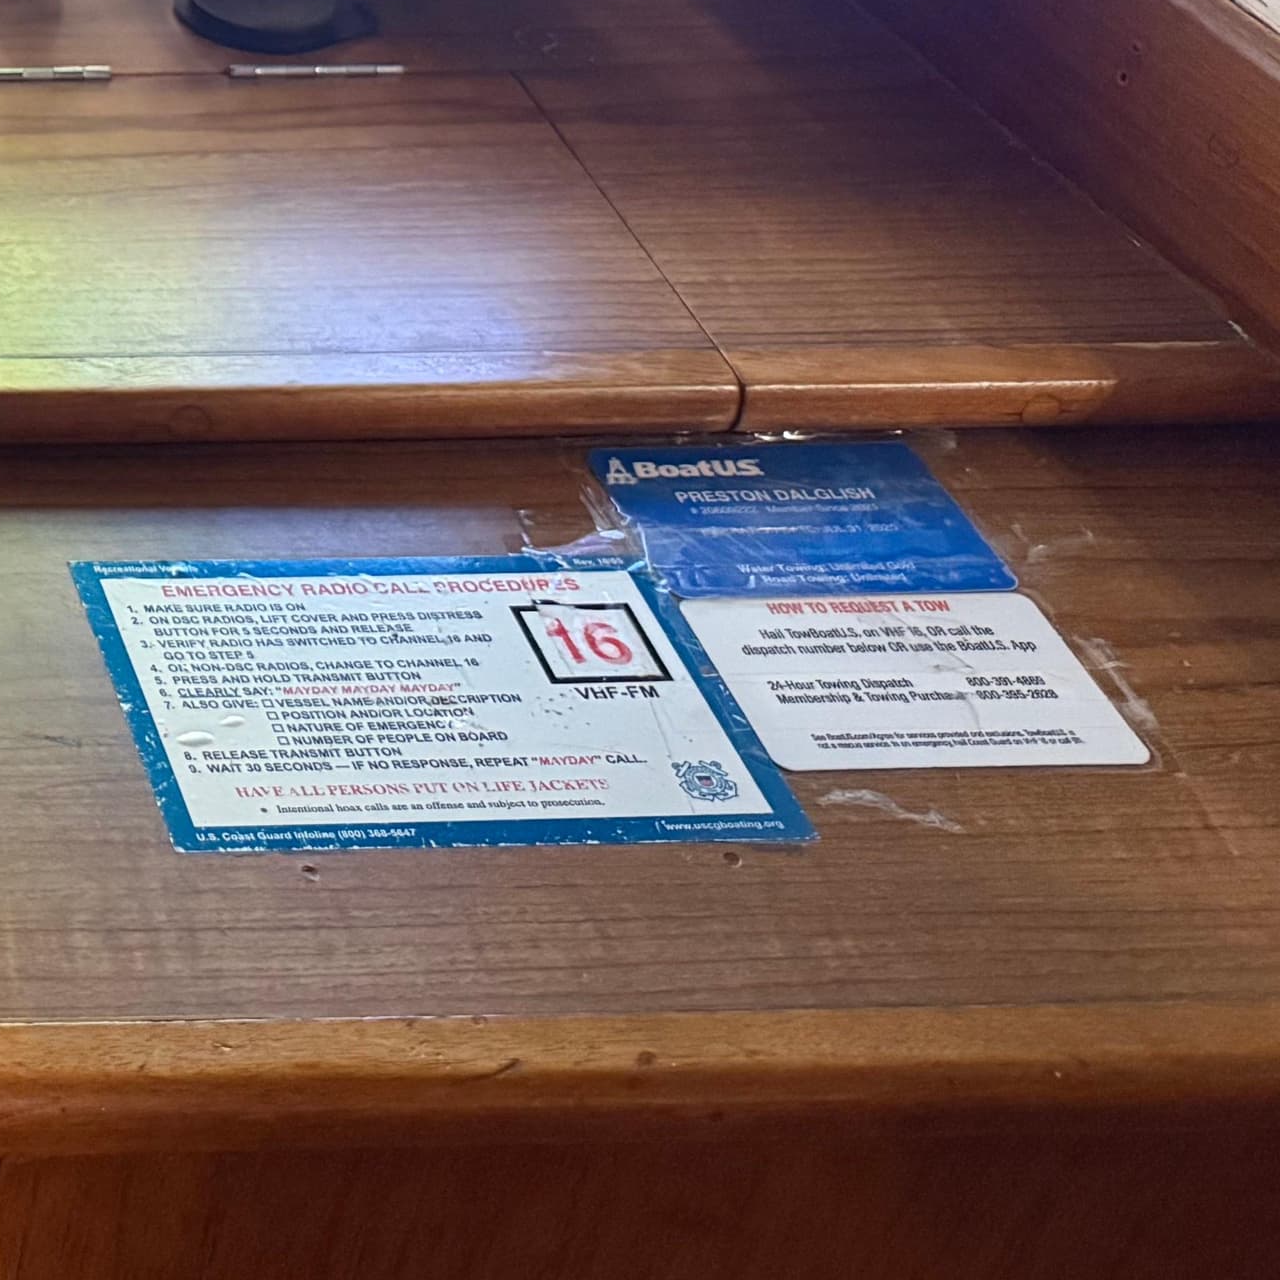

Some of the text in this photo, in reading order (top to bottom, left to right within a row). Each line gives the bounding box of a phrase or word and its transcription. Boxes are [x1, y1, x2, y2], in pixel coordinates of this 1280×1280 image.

[633, 459, 765, 478] BoatUS
[675, 488, 876, 503] PRESTON DALGLISH
[162, 584, 296, 598] EMERGENCY
[301, 582, 368, 596] RADIO
[144, 603, 306, 613] MAKE SURE RADIO IS ON
[767, 600, 951, 615] HOW TO REQUEST A TOW
[149, 610, 484, 625] ON DSC RADIOS, LIFT COVER AND PRESS DISTRESS
[154, 623, 414, 636] BUTTON FOR 5 SECONDS AND RELEASE
[759, 628, 786, 640] Hail
[863, 628, 880, 637] on
[881, 626, 907, 637] VHF
[927, 625, 947, 636] OR
[948, 625, 969, 636] call
[971, 624, 994, 636] the
[546, 618, 633, 665] 16
[741, 644, 796, 658] dispatch
[798, 643, 847, 655] number
[849, 642, 888, 654] below
[889, 641, 908, 653] OR
[910, 643, 933, 652] use
[934, 640, 956, 652] the
[1012, 640, 1037, 654] App
[172, 671, 422, 685] PRESS AND HOLD TRANSMIT BUTTON
[767, 680, 814, 691] 24-Hour
[816, 678, 861, 692] Towing
[860, 677, 913, 692] Dispatch
[576, 686, 660, 700] VHF-FM
[776, 692, 852, 704] Membership
[855, 691, 866, 702] &
[867, 690, 910, 704] Towing
[202, 746, 403, 761] RELEASE TRANSMIT BUTTON
[206, 763, 246, 774] WAIT
[247, 763, 262, 772] 30
[265, 762, 334, 772] SECONDS
[352, 762, 366, 770] IF
[368, 760, 390, 770] NO
[391, 758, 474, 770] RESPONSE,
[476, 756, 530, 767] REPEAT
[605, 754, 648, 764] CALL.
[662, 818, 785, 832] www.uscgboating.org
[196, 832, 219, 841] U.S.
[222, 831, 256, 841] Coast
[258, 830, 292, 840] Guard
[294, 829, 336, 839] Infoline
[337, 828, 366, 840] (800)
